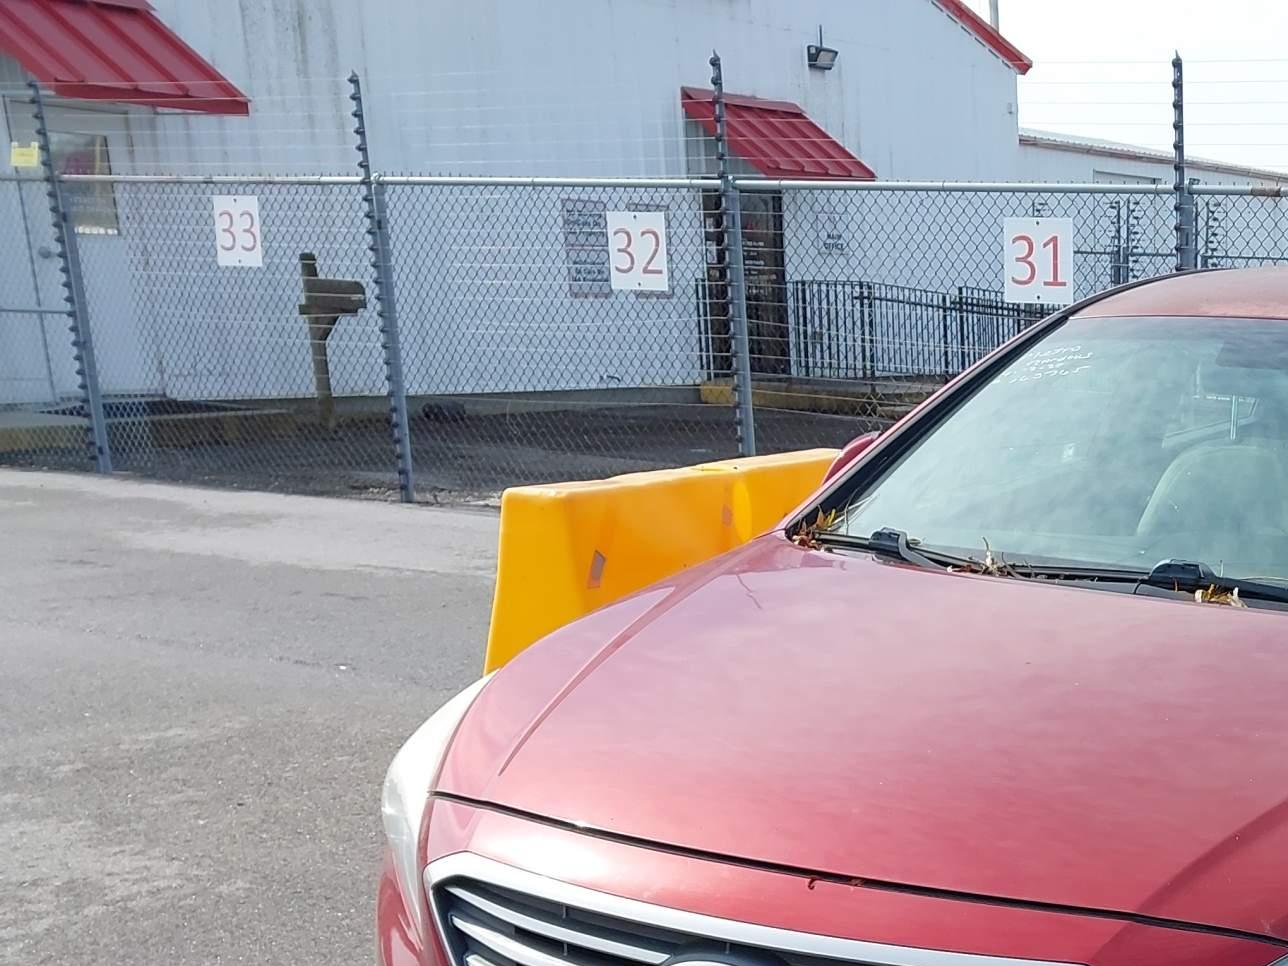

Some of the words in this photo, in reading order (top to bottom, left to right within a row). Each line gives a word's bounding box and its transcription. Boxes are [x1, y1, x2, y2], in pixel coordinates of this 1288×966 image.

[218, 210, 257, 252] 33
[613, 227, 663, 274] 32
[1011, 235, 1067, 287] 31
